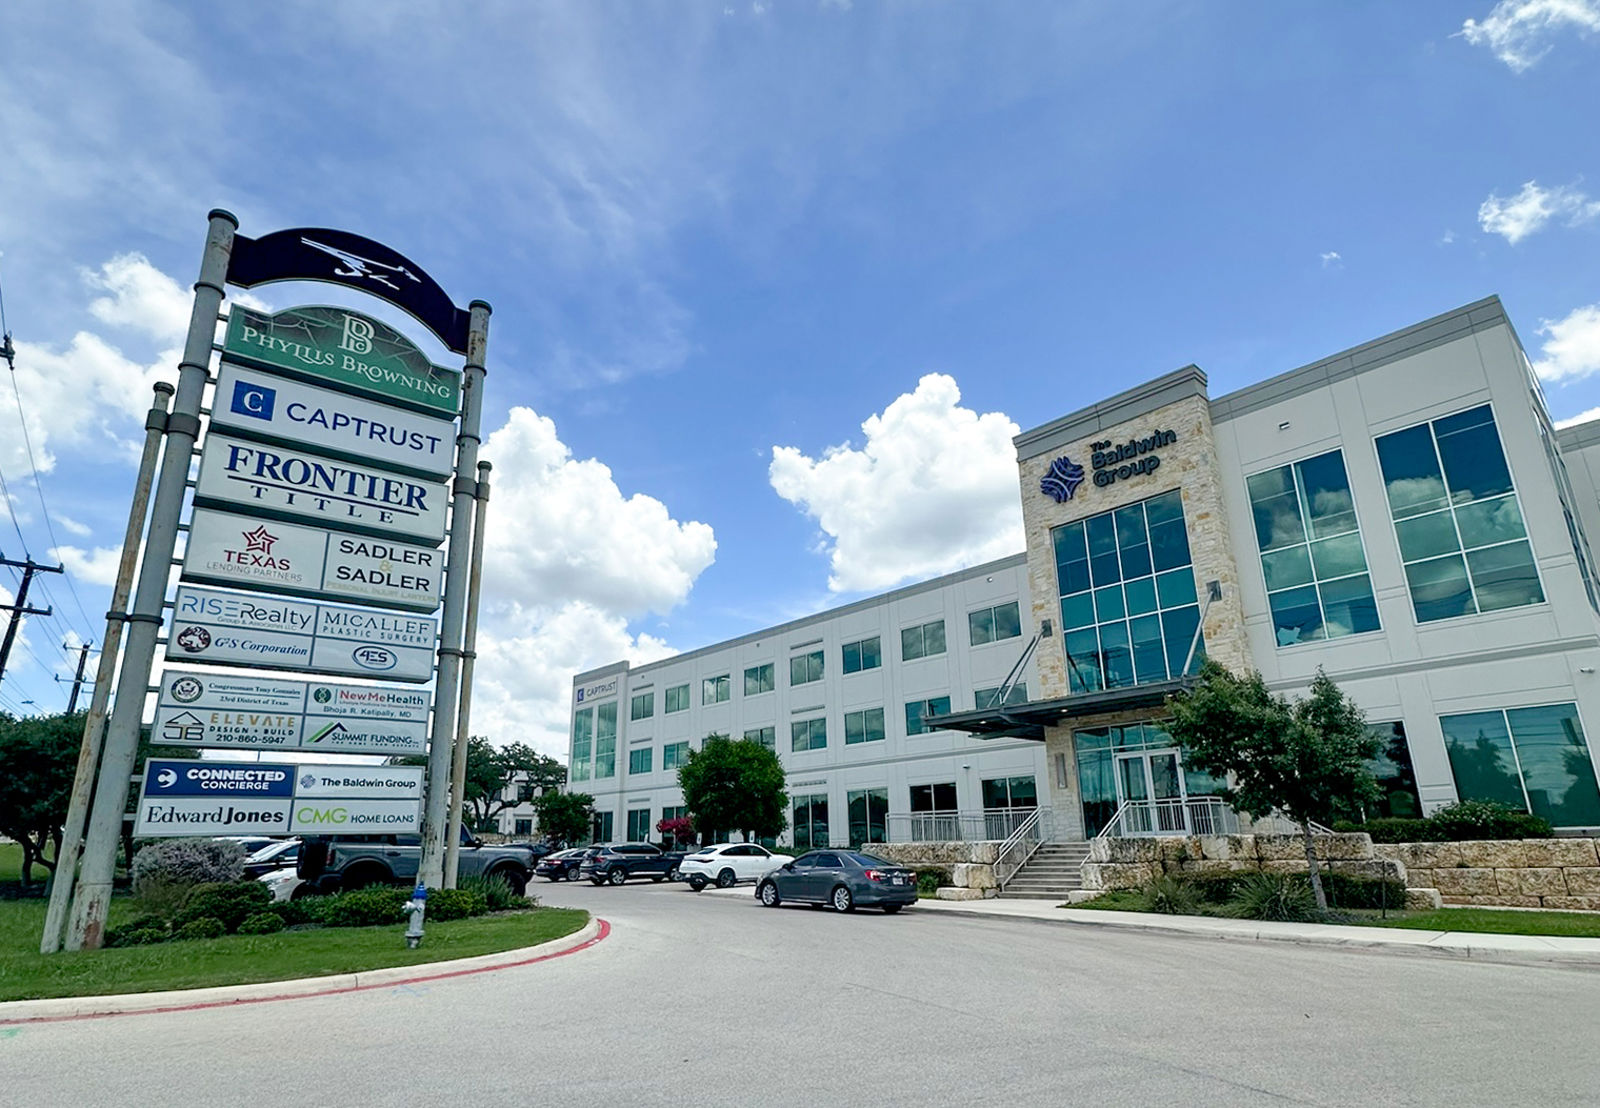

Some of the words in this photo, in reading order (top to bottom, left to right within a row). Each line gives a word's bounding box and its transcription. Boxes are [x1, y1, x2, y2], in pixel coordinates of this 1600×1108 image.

[241, 326, 334, 365] PHYLLIS
[342, 355, 450, 398] BROWNING
[243, 391, 264, 413] C
[286, 403, 441, 454] CAPTRUST
[1090, 439, 1112, 452] The
[1091, 428, 1177, 470] Baldwin
[224, 444, 429, 511] FRONTIER
[1093, 454, 1160, 487] Group
[250, 485, 394, 524] TITLE
[224, 549, 290, 571] TEXAS
[340, 539, 432, 567] SADLER
[206, 561, 251, 574] LENDING
[253, 568, 303, 582] PARTNERS
[379, 560, 393, 573] &
[336, 565, 430, 592] SADLER
[324, 611, 430, 634] MICALLEF
[322, 625, 371, 638] PLASTIC
[380, 632, 429, 644] SURGERY
[241, 639, 308, 656] Corporation
[340, 690, 424, 705] NewMeHealth
[586, 681, 616, 697] CAPTRUST
[210, 712, 296, 728] ELEVATE
[323, 705, 347, 714] Bhoja
[399, 710, 412, 718] MD
[209, 725, 249, 734] DESIGN
[263, 728, 295, 736] BUILD
[331, 732, 368, 742] SUMMIT
[370, 734, 412, 744] FUNDING
[186, 768, 286, 782] CONNECTED
[321, 777, 341, 786] The
[343, 777, 384, 787] Baldwin
[385, 780, 417, 789] Group
[200, 780, 270, 790] CONCIERGE
[297, 807, 348, 824] CMG
[350, 814, 381, 823] HOME
[382, 814, 415, 823] LOANS
